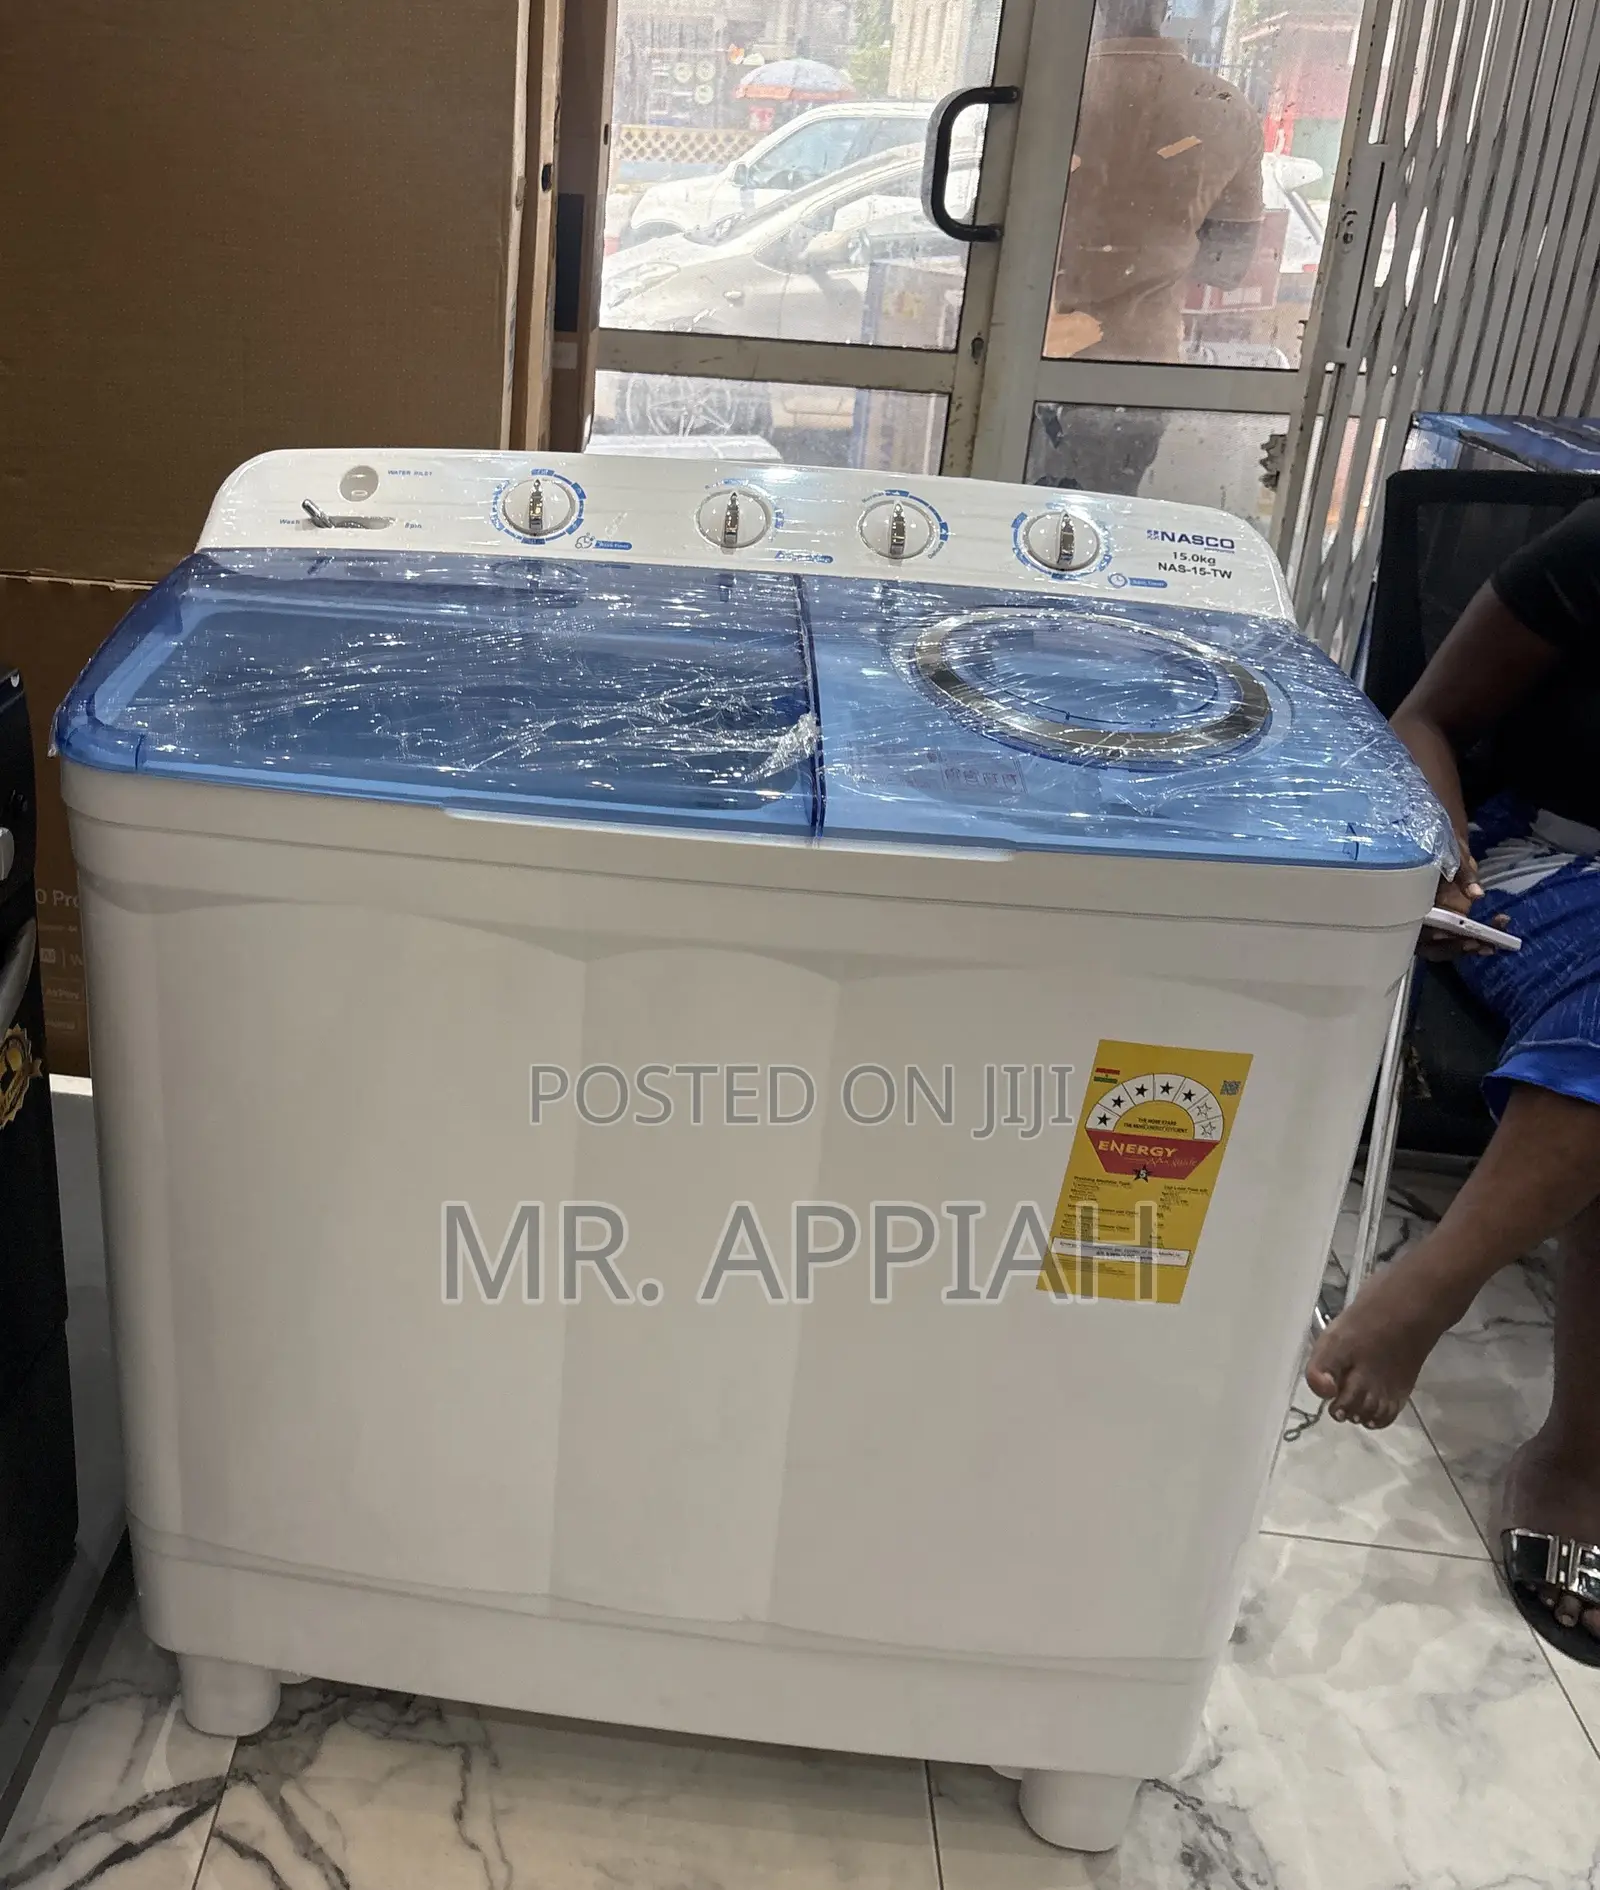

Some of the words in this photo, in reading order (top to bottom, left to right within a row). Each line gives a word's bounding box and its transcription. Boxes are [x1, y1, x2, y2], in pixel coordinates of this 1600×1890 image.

[1160, 531, 1235, 549] NASCO
[1172, 551, 1216, 567] 15.0kg
[1157, 561, 1233, 579] NAS-15-TW
[1097, 1139, 1177, 1157] ENERGY
[1139, 1170, 1147, 1178] 5
